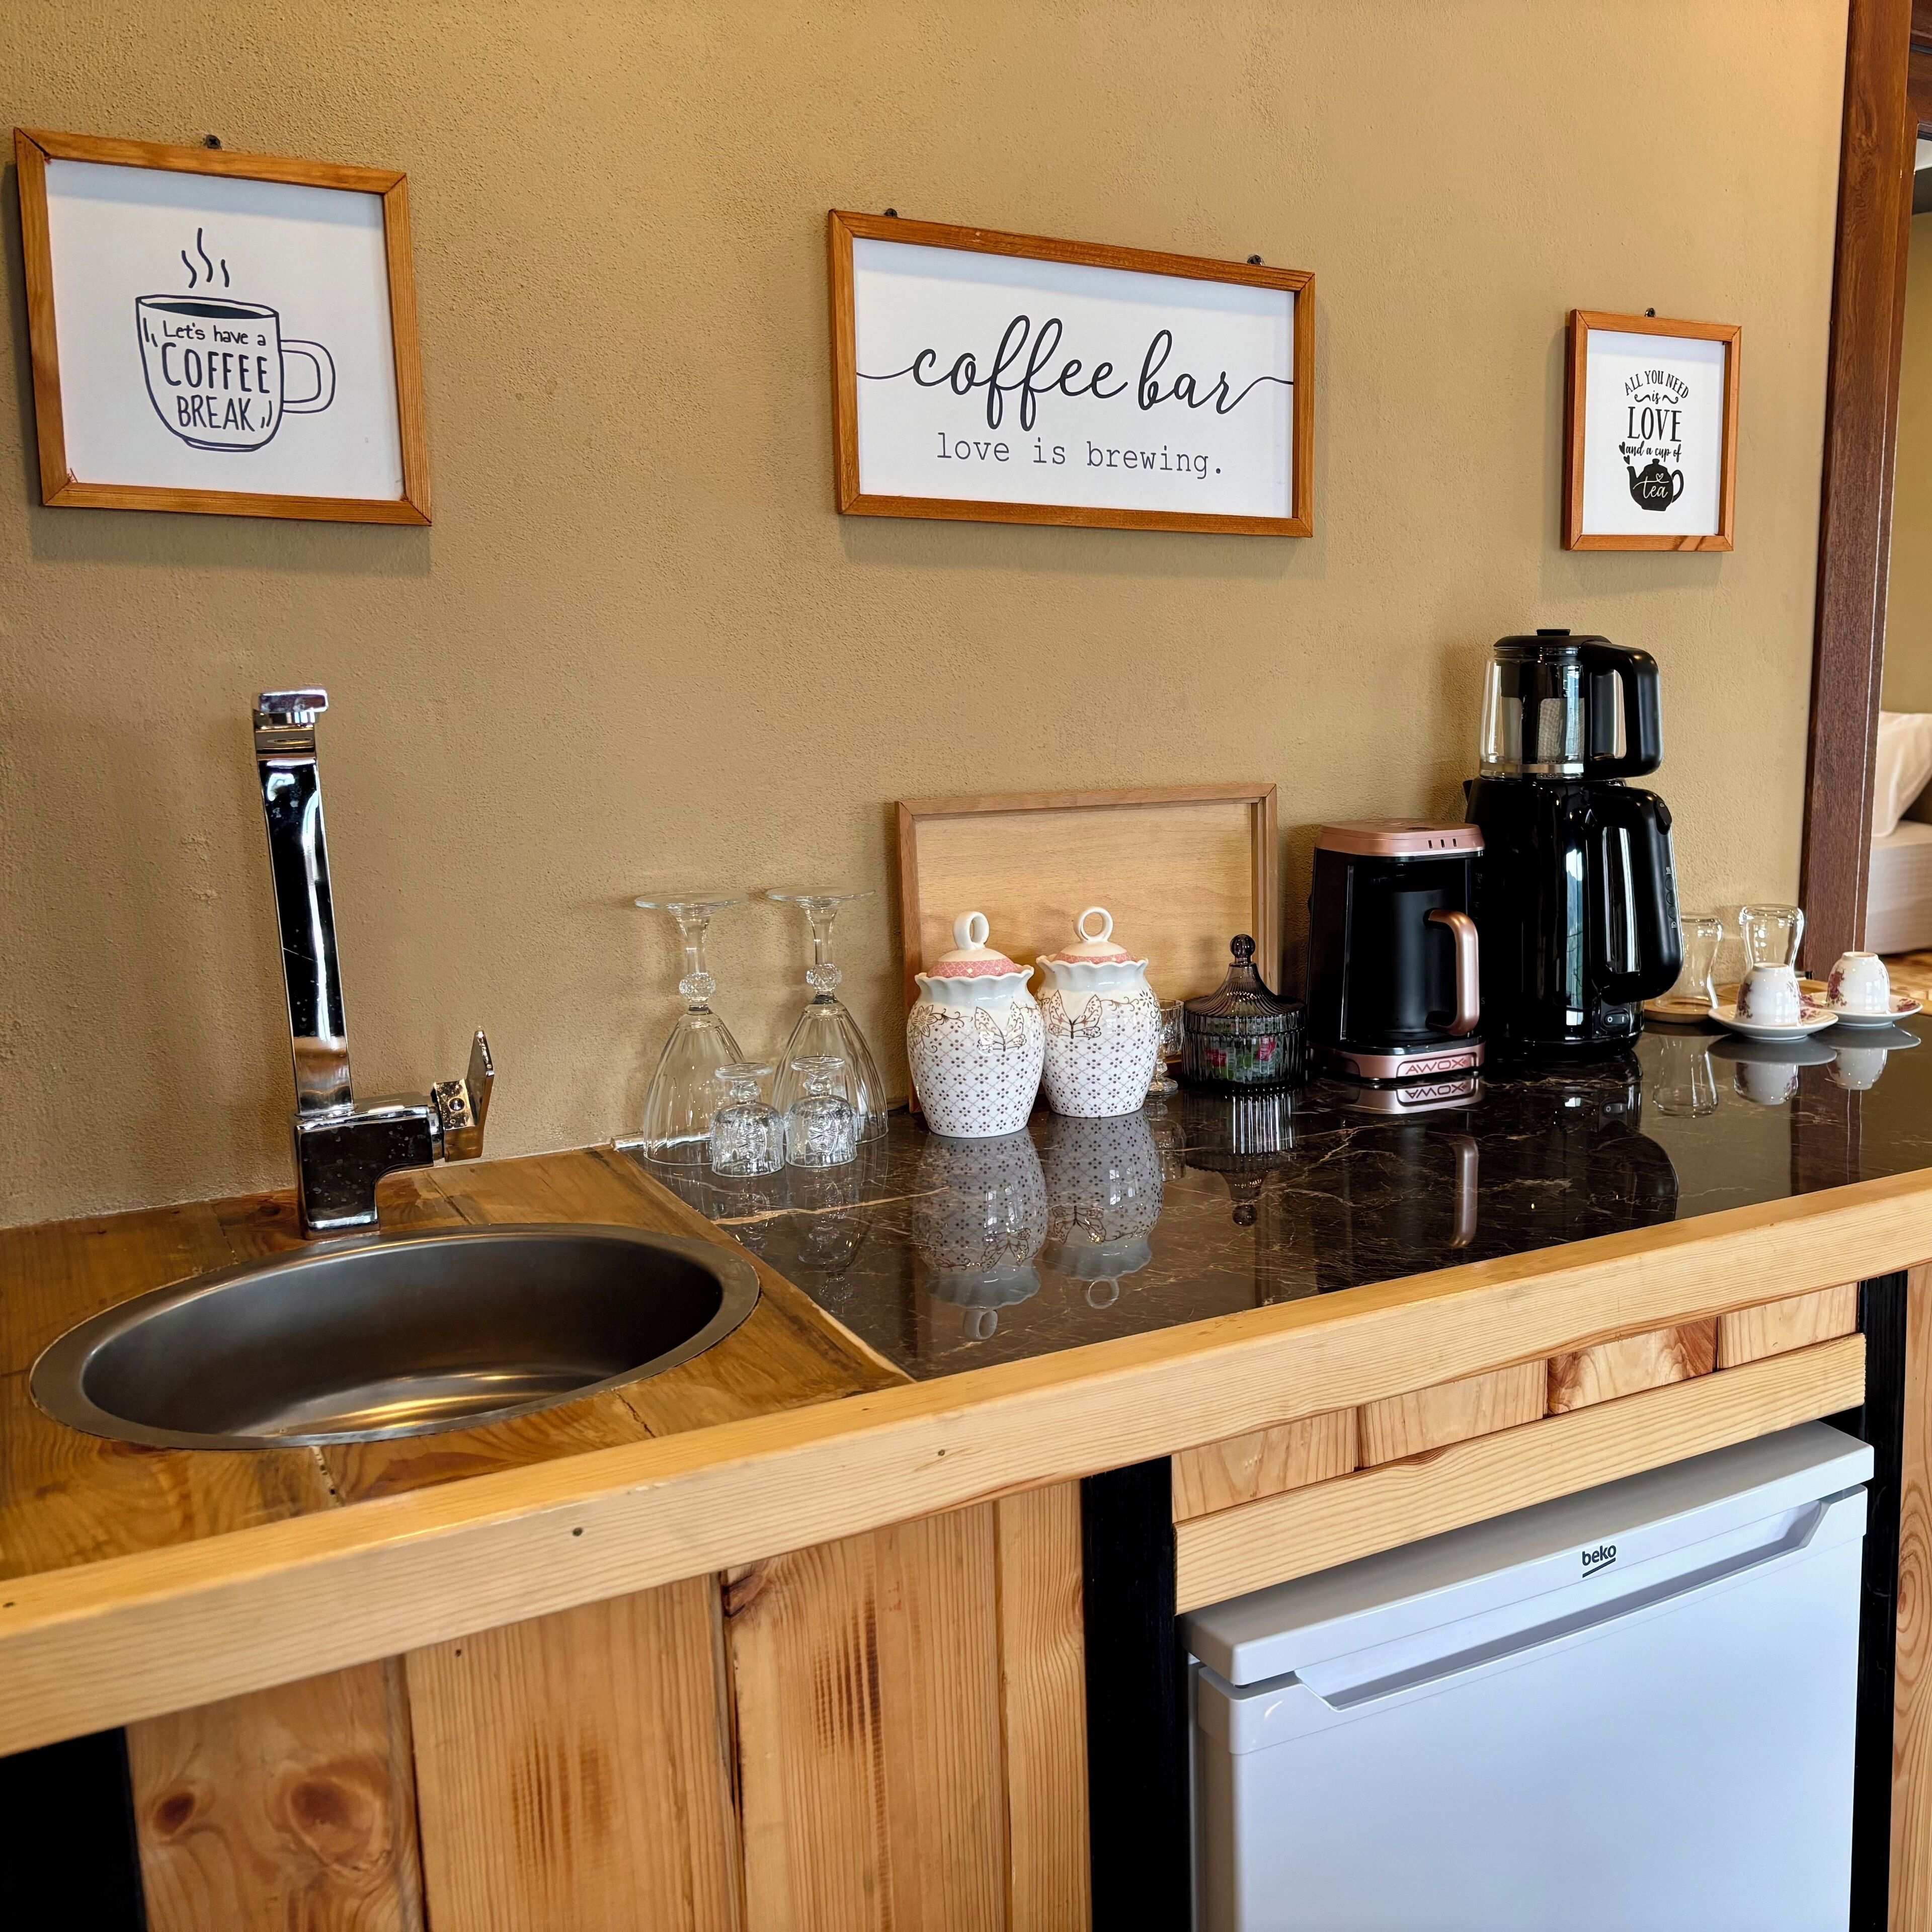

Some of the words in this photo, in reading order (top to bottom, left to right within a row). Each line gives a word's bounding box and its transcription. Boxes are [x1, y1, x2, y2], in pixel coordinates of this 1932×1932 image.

[163, 320, 205, 341] Let's
[213, 325, 249, 344] have
[257, 334, 266, 347] a
[161, 343, 271, 394] COFFEE
[906, 315, 1128, 431] coffee
[1138, 330, 1254, 414] bar
[1625, 374, 1643, 396] ALL
[1644, 370, 1664, 385] YOU
[1665, 373, 1689, 398] NEED
[1652, 390, 1661, 405] is
[177, 394, 255, 432] BREAK
[1627, 406, 1682, 442] LOVE
[937, 432, 1009, 462] love
[1032, 437, 1066, 465] is
[1087, 442, 1222, 479] brewing.
[1626, 440, 1645, 456] and
[1646, 446, 1652, 455] a
[1655, 446, 1671, 462] cup
[1673, 443, 1682, 463] of
[1633, 475, 1669, 499] tea
[1406, 1058, 1465, 1074] AWOX
[1582, 1545, 1617, 1566] beko
